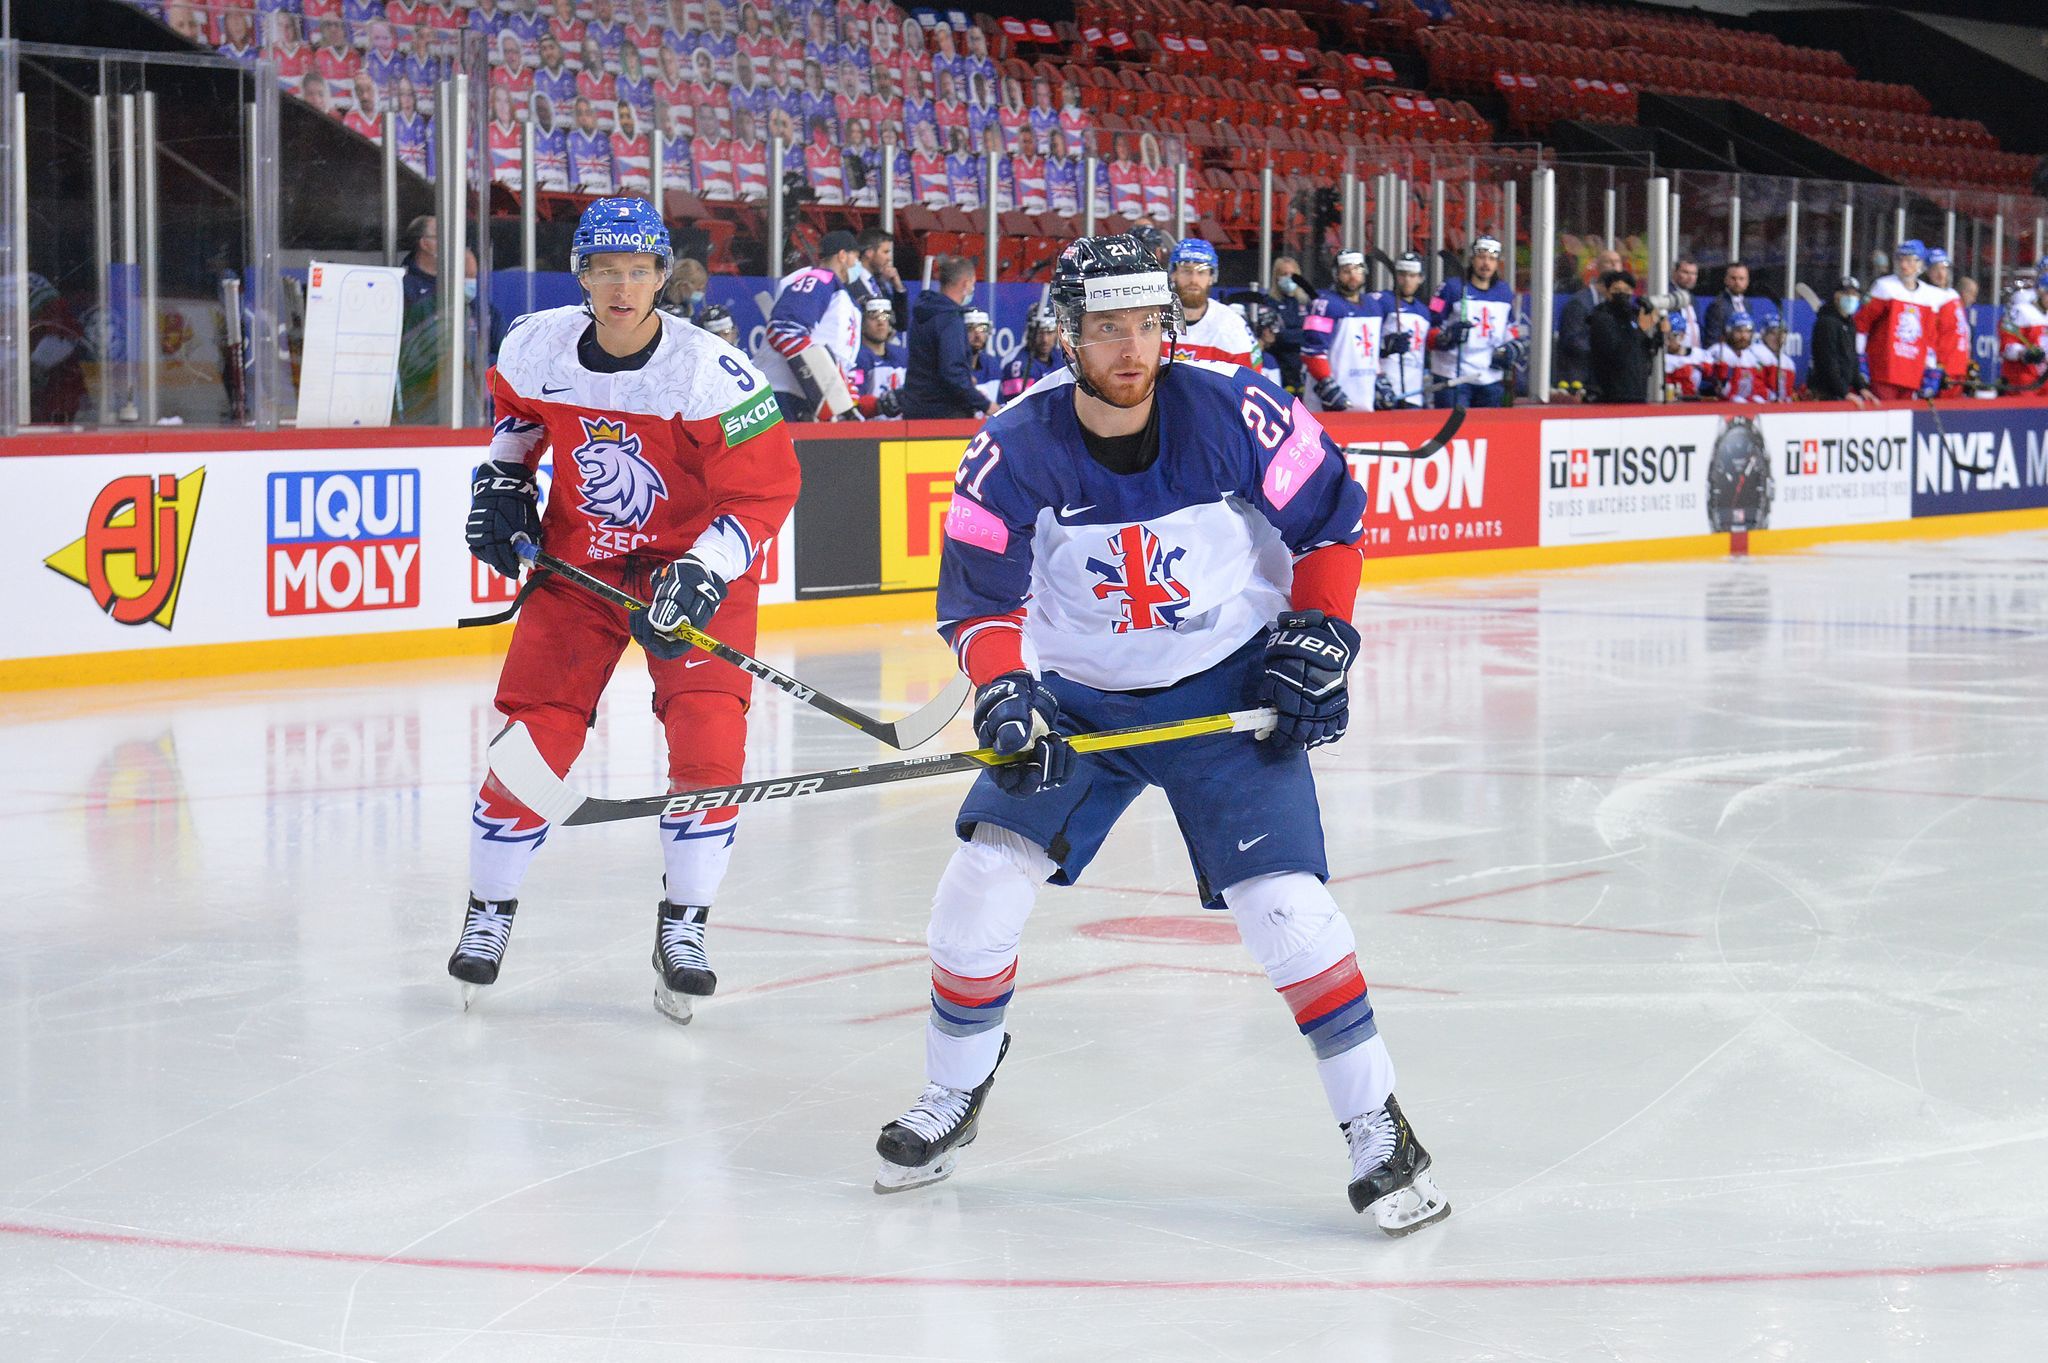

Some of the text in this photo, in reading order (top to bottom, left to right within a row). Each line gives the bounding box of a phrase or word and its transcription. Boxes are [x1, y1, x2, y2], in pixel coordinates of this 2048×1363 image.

[594, 234, 642, 246] ENYAQ
[1106, 243, 1130, 257] 21
[1089, 284, 1166, 299] ICETECHUK
[718, 355, 755, 392] 9
[724, 394, 779, 438] ŠKOD
[1241, 386, 1291, 449] 21
[955, 430, 1000, 502] 21
[1593, 445, 1696, 487] TISSOT
[1822, 437, 1907, 475] TISSOT
[1916, 428, 2020, 495] NIVEA
[473, 477, 539, 500] CCM
[1343, 438, 1488, 521] TRON
[1783, 485, 1814, 503] SWISS
[273, 474, 414, 541] LIQUI
[1548, 499, 1583, 518] SWISS
[1588, 495, 1637, 515] WATCHES
[1641, 493, 1672, 512] SINCE
[949, 514, 1000, 541] ROPE
[1407, 519, 1503, 542] AUTO PARTS
[273, 543, 419, 612] MOLY
[1266, 630, 1345, 663] AUER
[738, 656, 817, 704] CCM
[662, 777, 824, 816] BAUER
